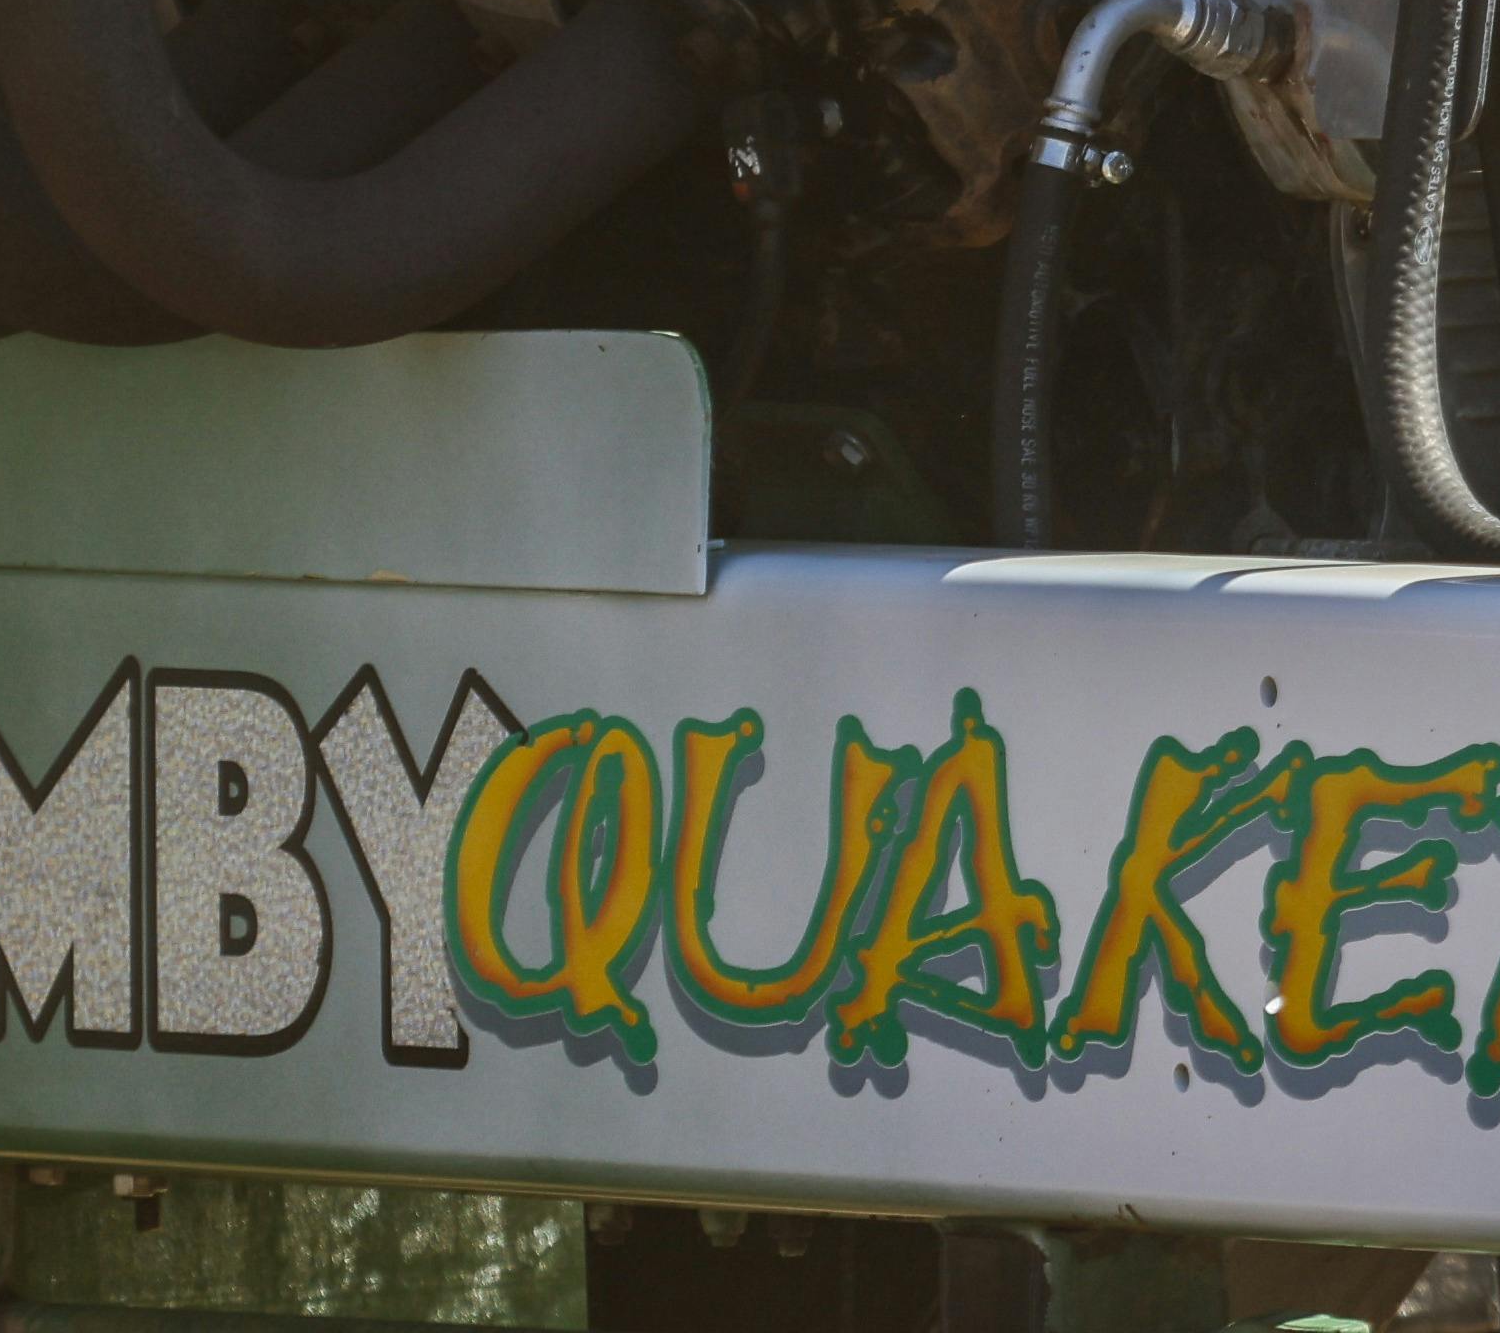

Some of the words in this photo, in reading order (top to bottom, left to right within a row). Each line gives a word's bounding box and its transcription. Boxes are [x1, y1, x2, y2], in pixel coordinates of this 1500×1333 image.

[1424, 166, 1442, 213] GATES
[1437, 101, 1452, 136] INCH
[1022, 356, 1042, 392] FUEL
[1021, 398, 1039, 432] HOSE
[1020, 438, 1038, 465] SAE
